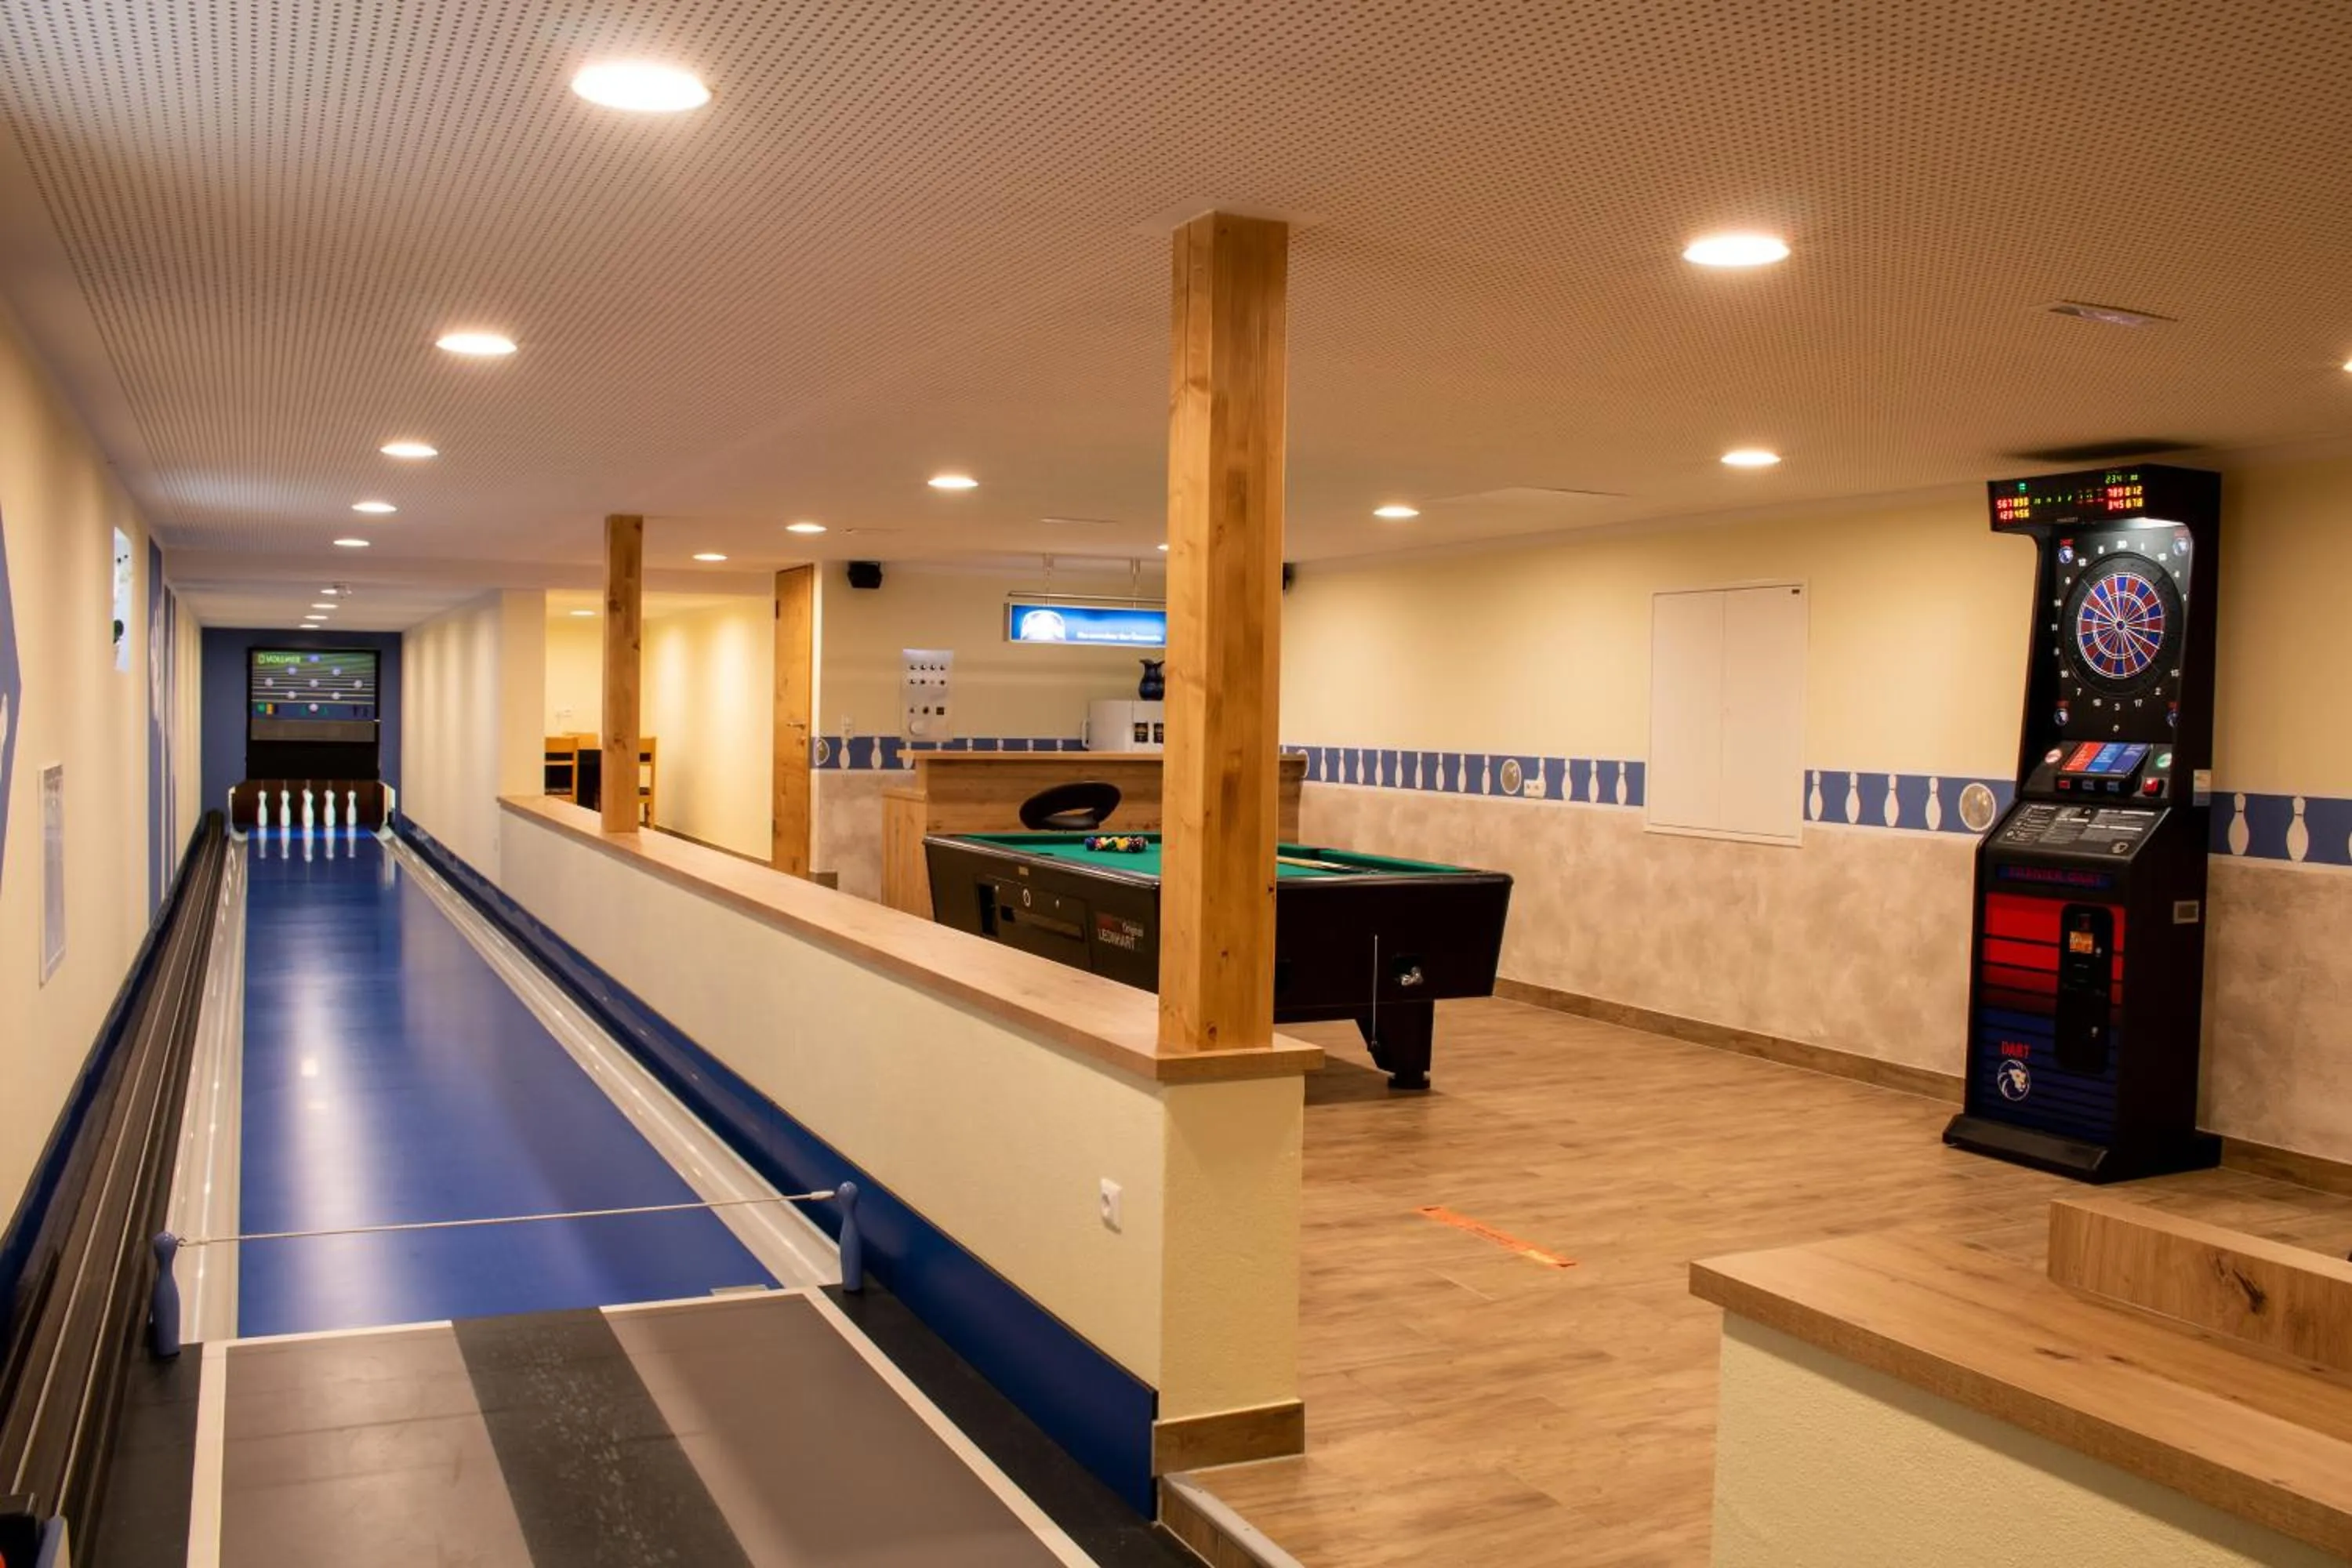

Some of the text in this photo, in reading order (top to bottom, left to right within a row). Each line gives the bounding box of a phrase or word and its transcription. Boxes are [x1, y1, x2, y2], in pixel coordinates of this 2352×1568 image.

[2076, 688, 2082, 696] 7
[2154, 687, 2161, 695] 2
[2134, 699, 2143, 707] 17
[2002, 1040, 2030, 1059] DART
